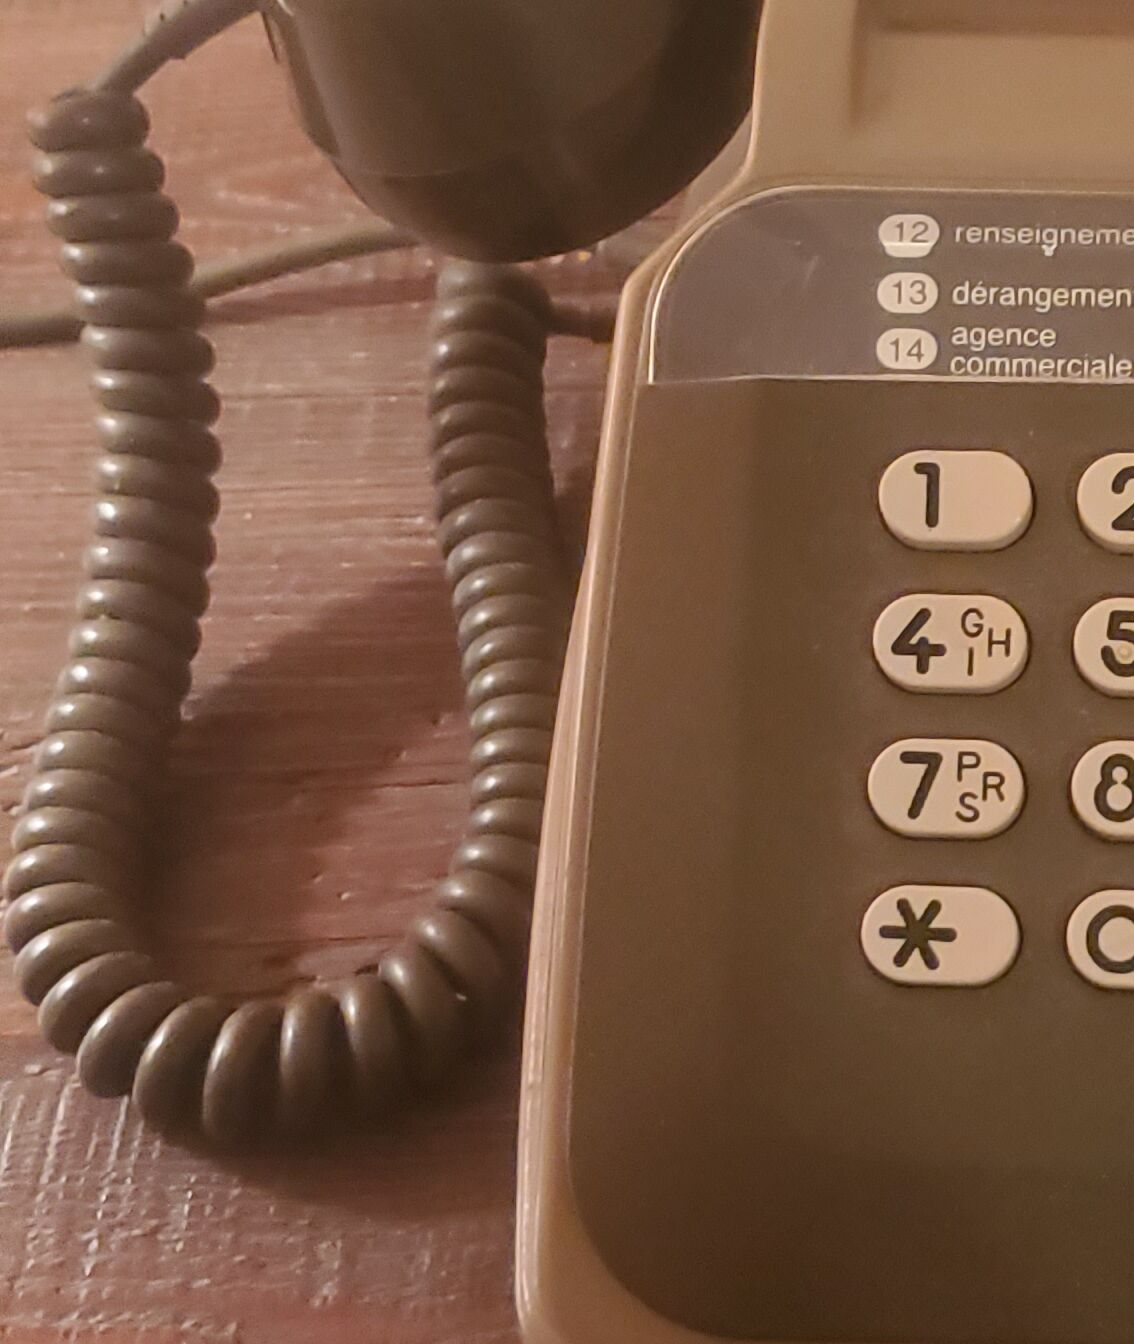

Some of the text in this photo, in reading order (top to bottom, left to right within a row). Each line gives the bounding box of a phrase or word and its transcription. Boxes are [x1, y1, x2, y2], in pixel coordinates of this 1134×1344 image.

[894, 221, 931, 244] 12
[891, 279, 928, 306] 13
[888, 336, 925, 363] 14
[950, 325, 1057, 352] agence
[950, 353, 1134, 379] commerciale
[914, 462, 940, 528] 1
[890, 607, 947, 675] 4
[899, 750, 944, 820] 7
